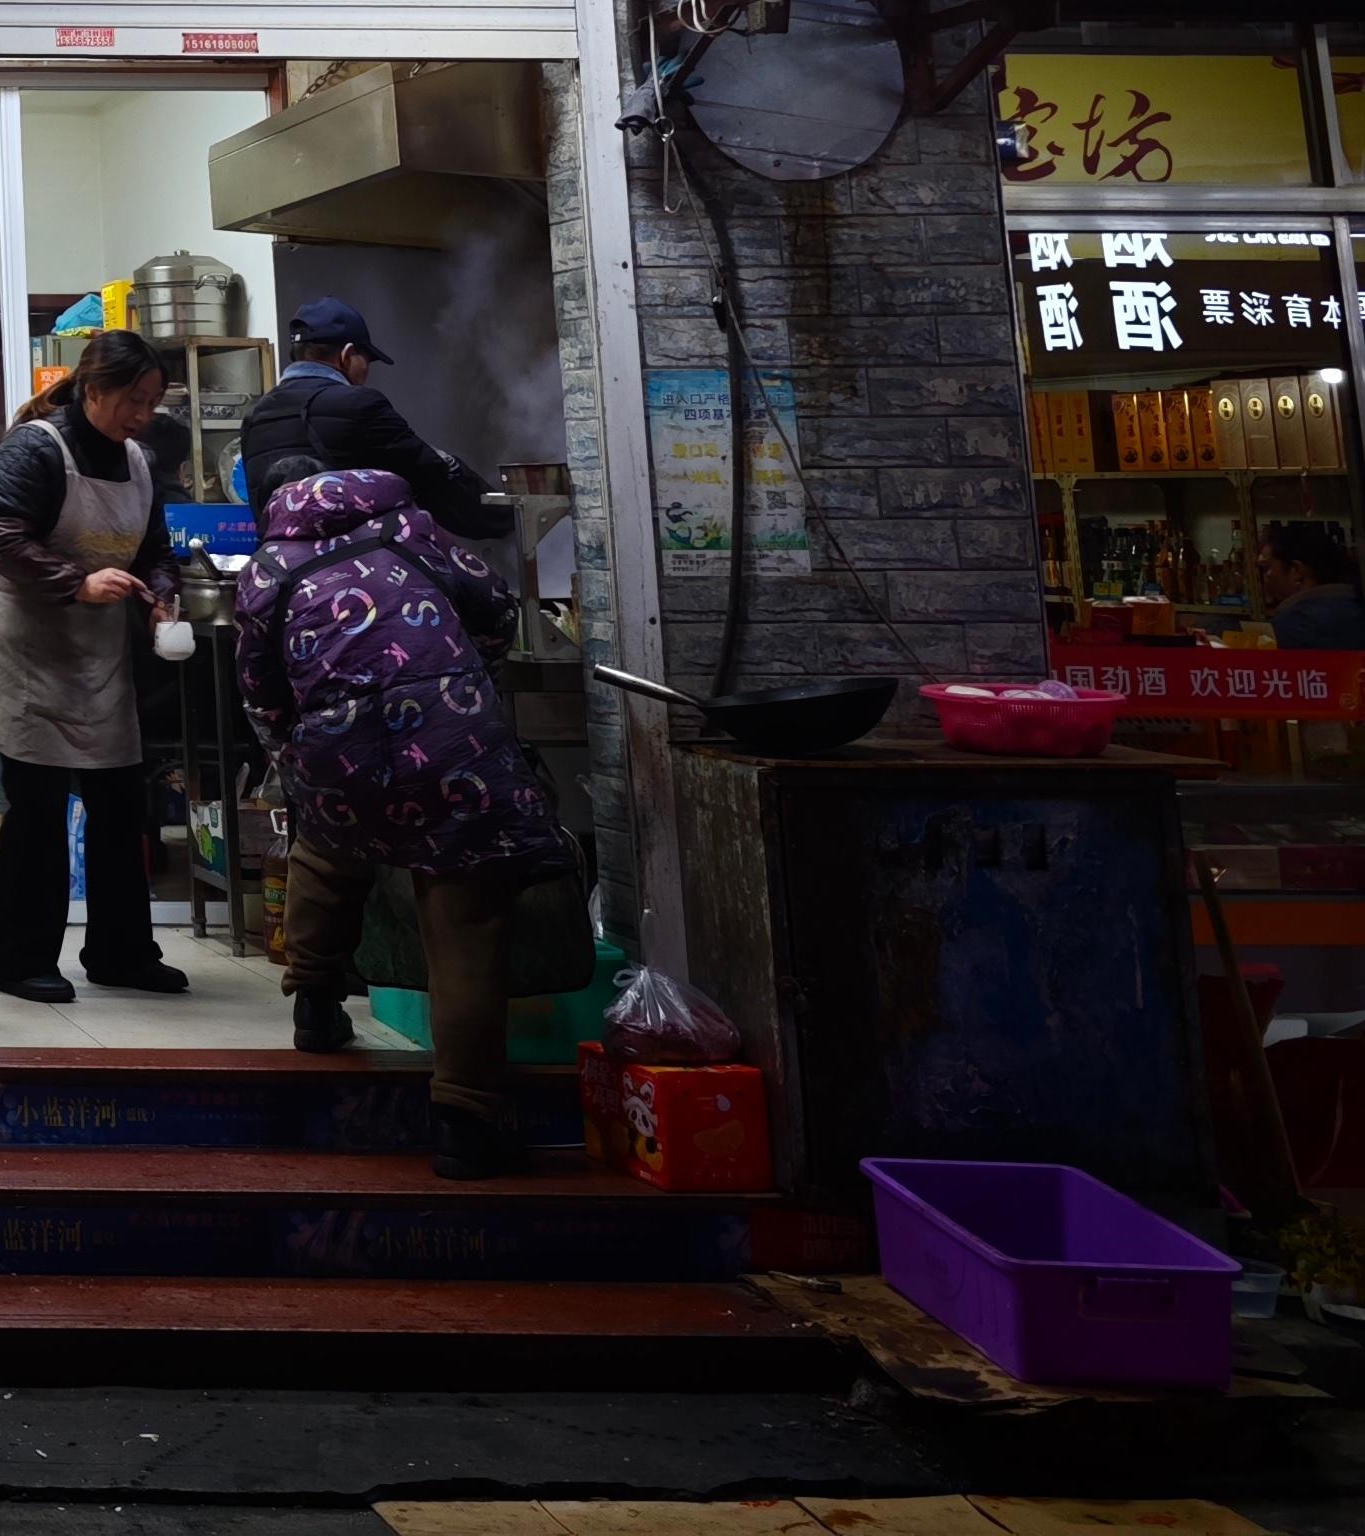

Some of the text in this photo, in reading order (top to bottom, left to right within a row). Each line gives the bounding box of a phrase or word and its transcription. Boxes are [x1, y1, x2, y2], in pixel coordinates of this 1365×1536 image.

[1050, 665, 1329, 700] 国劲酒 欢迎光临
